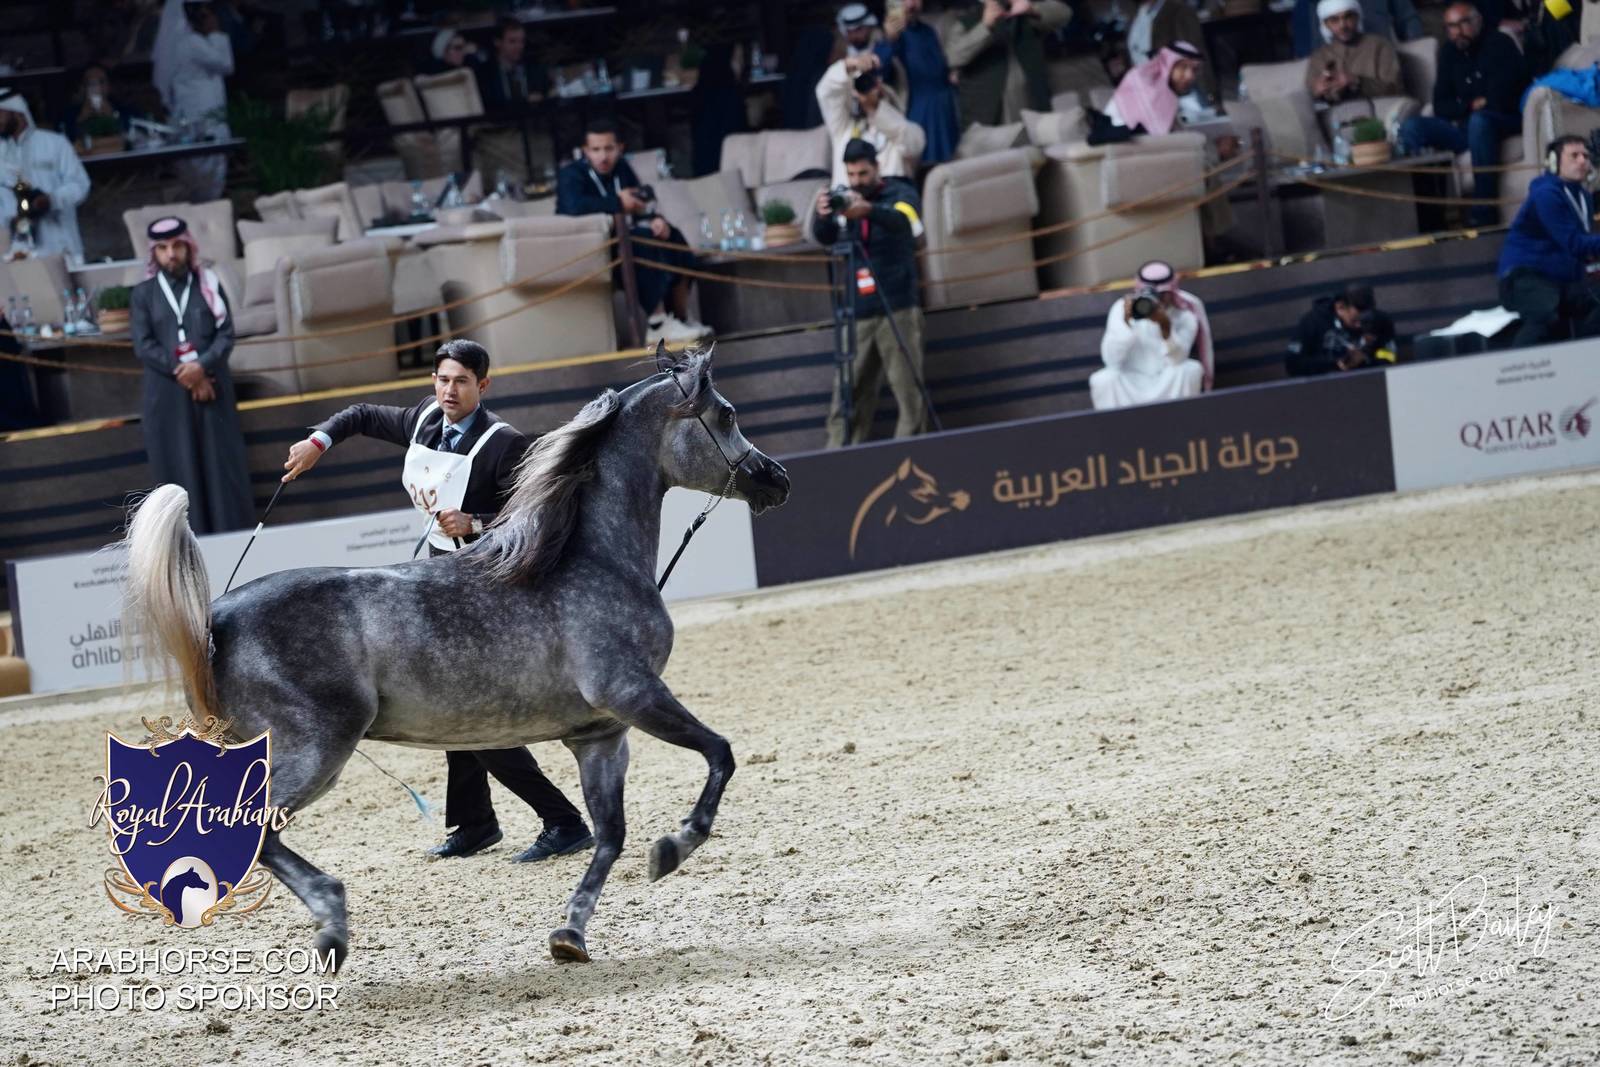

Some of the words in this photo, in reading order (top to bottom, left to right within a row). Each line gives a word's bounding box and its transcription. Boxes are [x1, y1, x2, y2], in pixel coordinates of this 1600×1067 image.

[1218, 432, 1299, 476] جولة
[1460, 410, 1554, 451] QATAR
[992, 453, 1108, 508] العربية
[1117, 438, 1209, 489] الجياد
